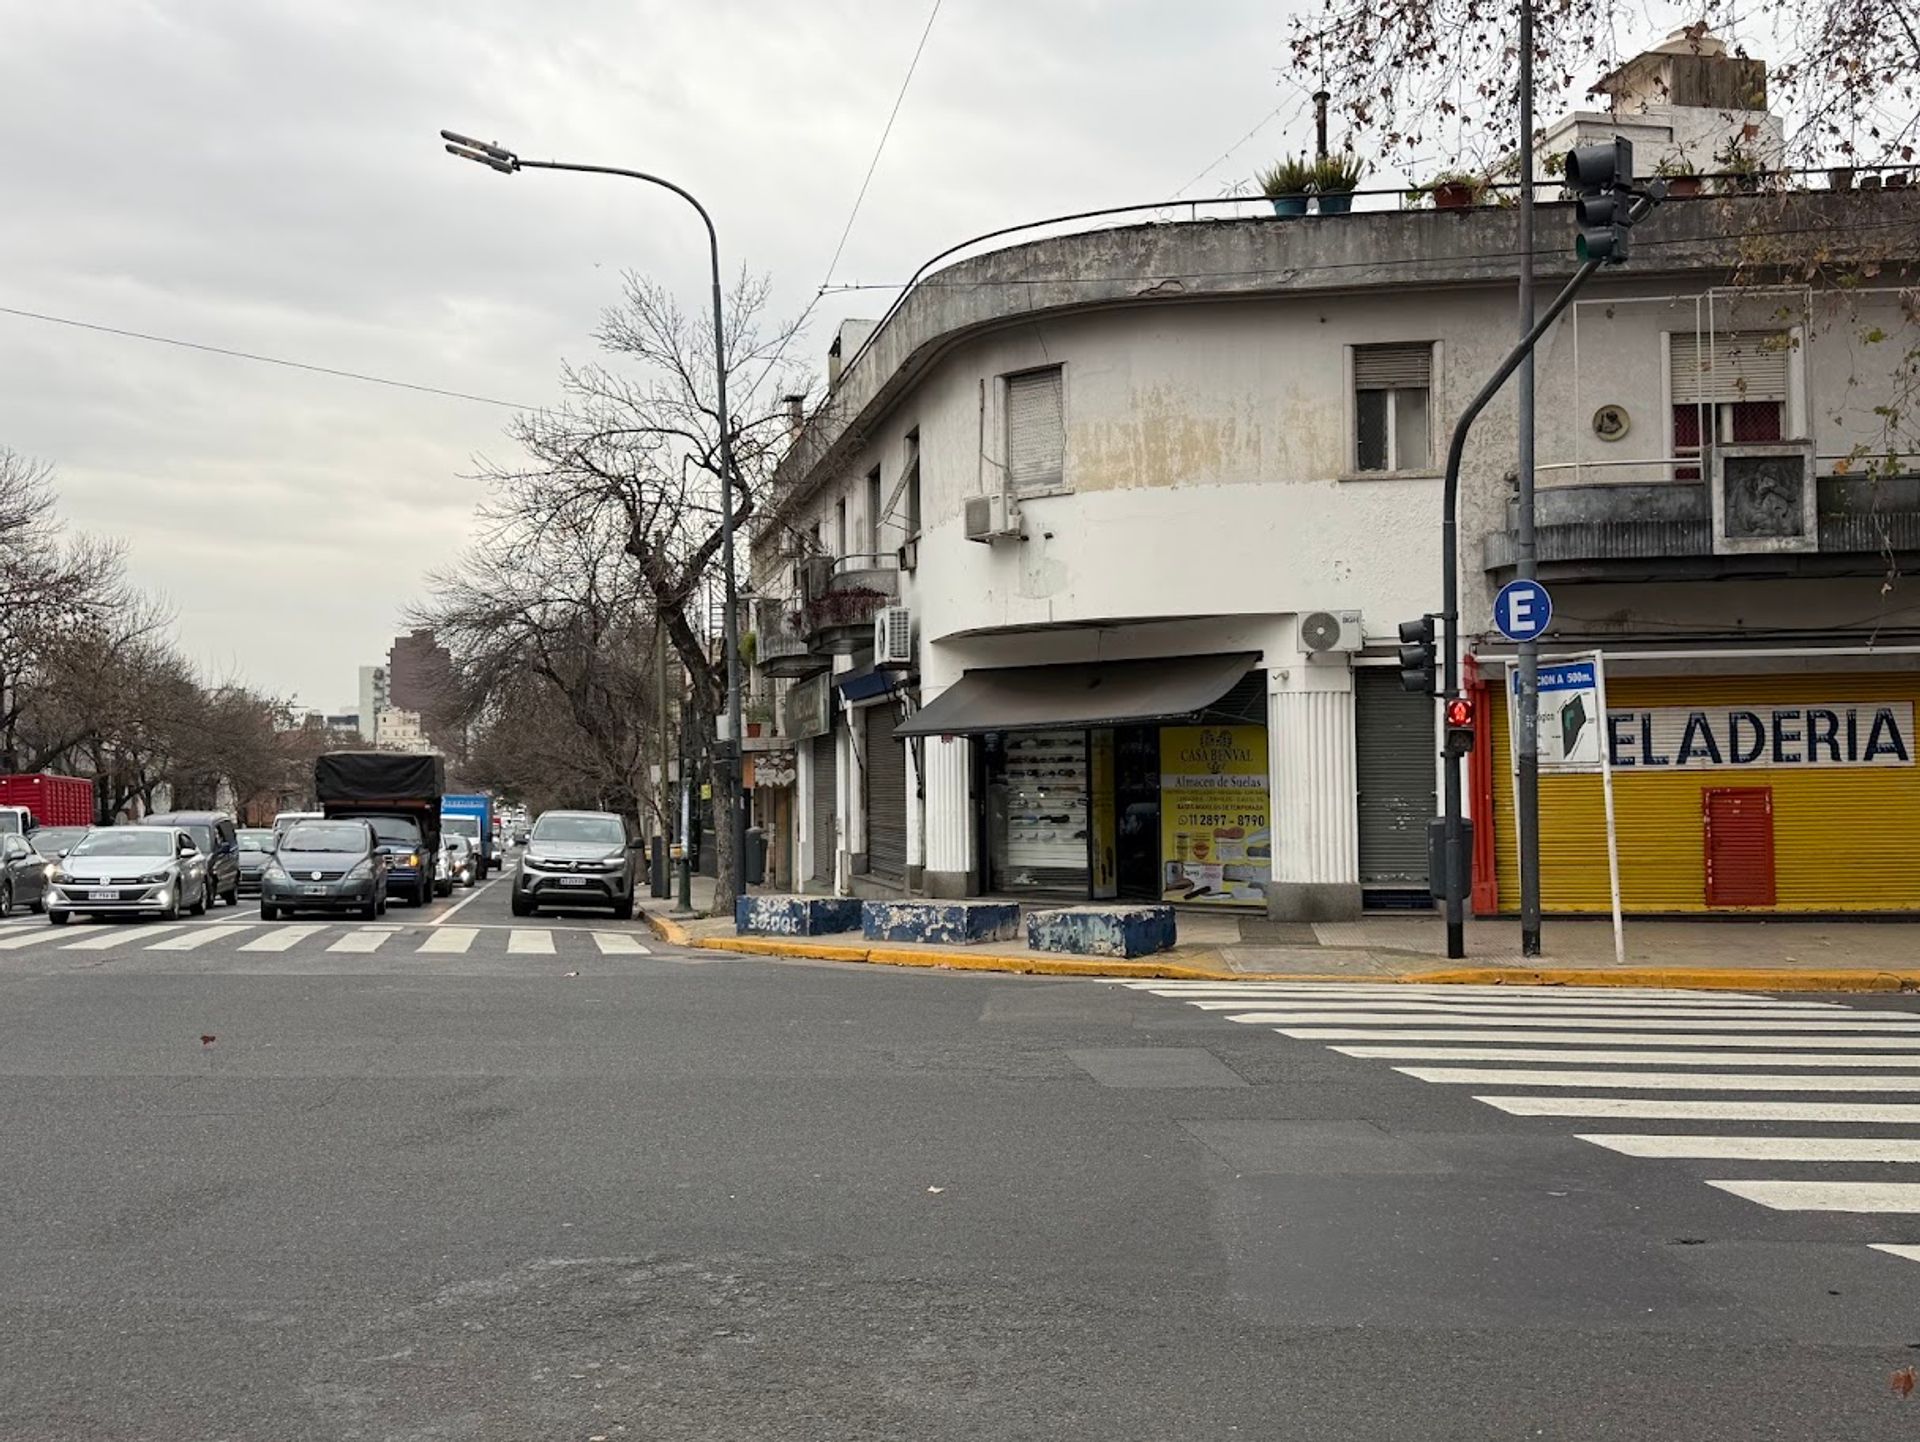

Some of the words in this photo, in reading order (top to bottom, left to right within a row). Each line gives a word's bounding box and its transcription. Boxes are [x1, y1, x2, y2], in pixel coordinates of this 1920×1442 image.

[1508, 590, 1536, 632] E
[1557, 673, 1564, 684] A
[1608, 708, 1909, 766] ELADERIA
[1180, 748, 1208, 762] CASA
[1175, 776, 1215, 787] Almacen
[1217, 776, 1228, 787] de
[1230, 776, 1262, 787] Suelas
[1189, 815, 1198, 826] 11
[1200, 815, 1227, 826] 2897
[1237, 815, 1265, 826] 8790
